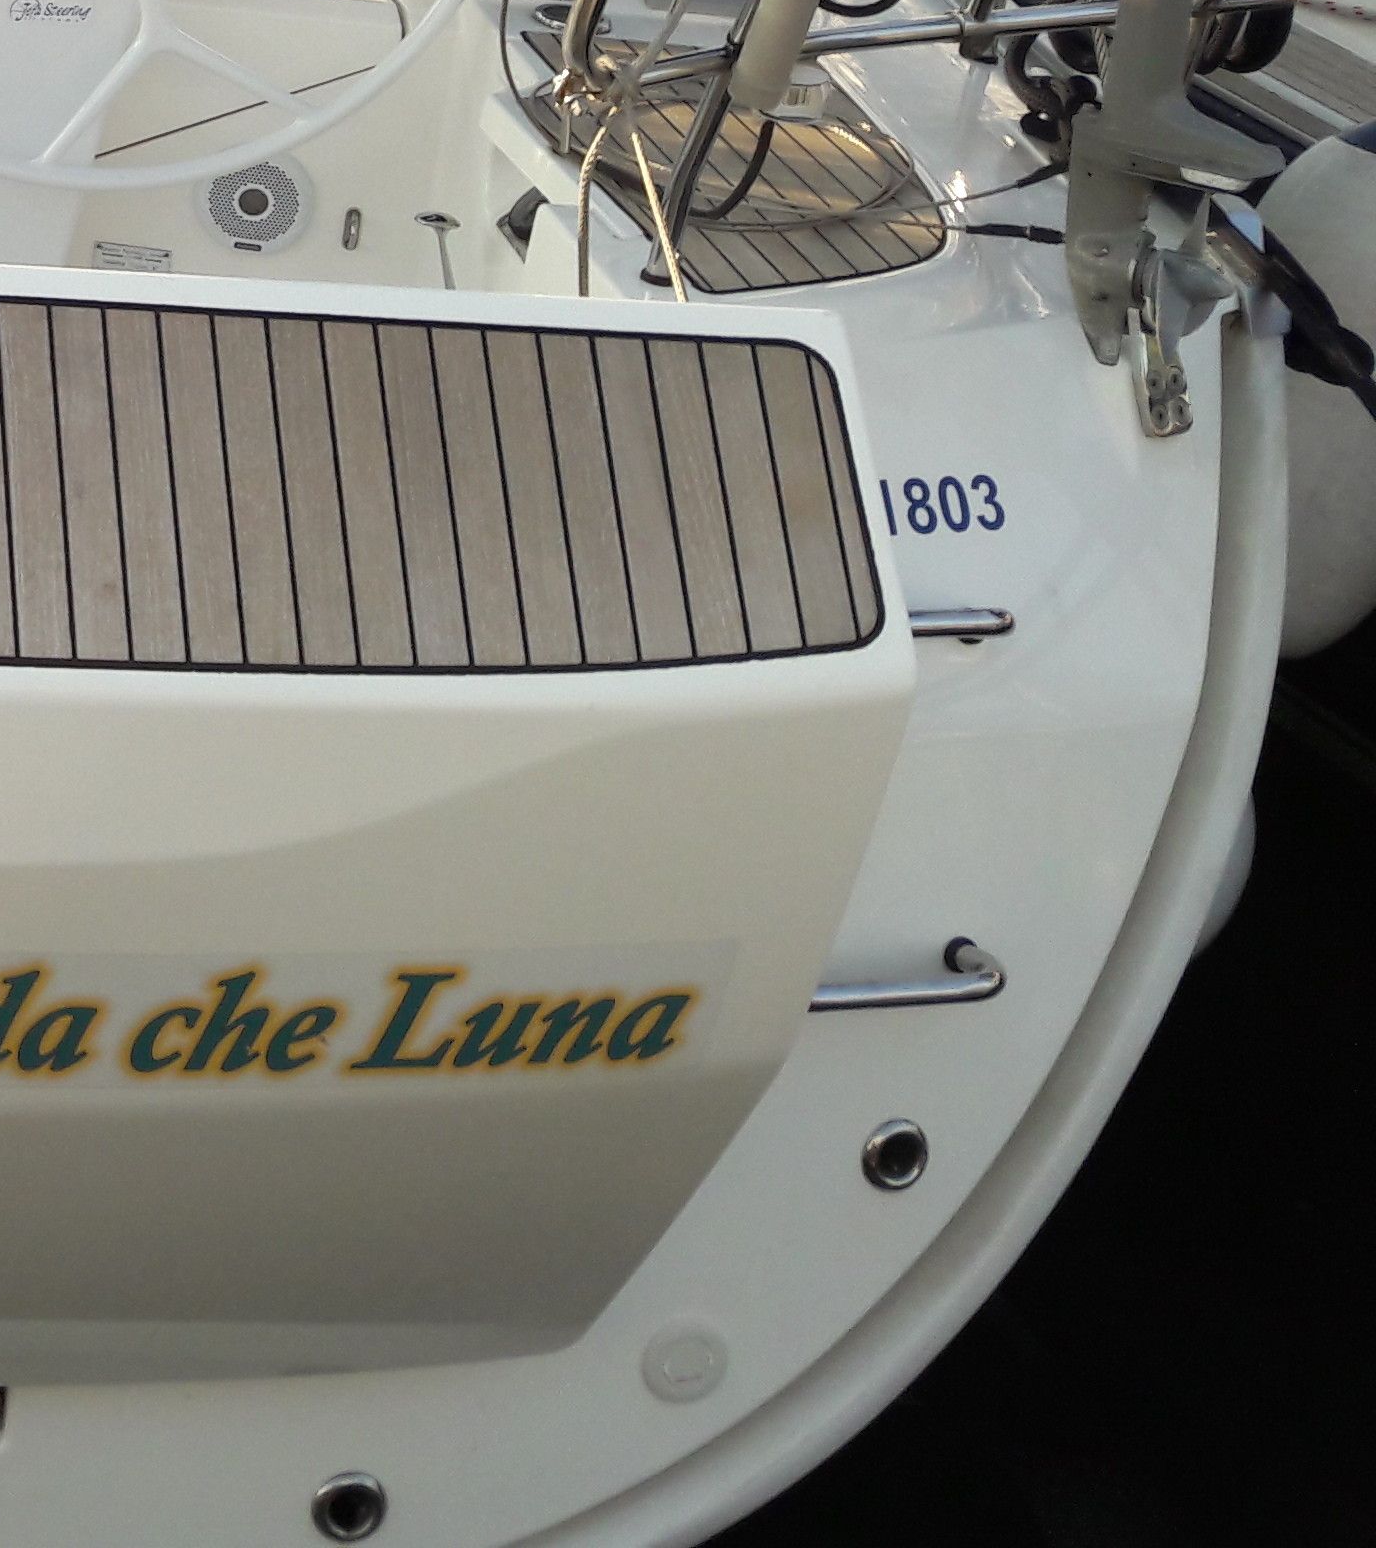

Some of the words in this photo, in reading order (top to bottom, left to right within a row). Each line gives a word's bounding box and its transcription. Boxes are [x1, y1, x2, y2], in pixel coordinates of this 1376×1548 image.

[879, 474, 1007, 537] 1803
[120, 969, 338, 1078] che
[347, 970, 698, 1074] Luna
